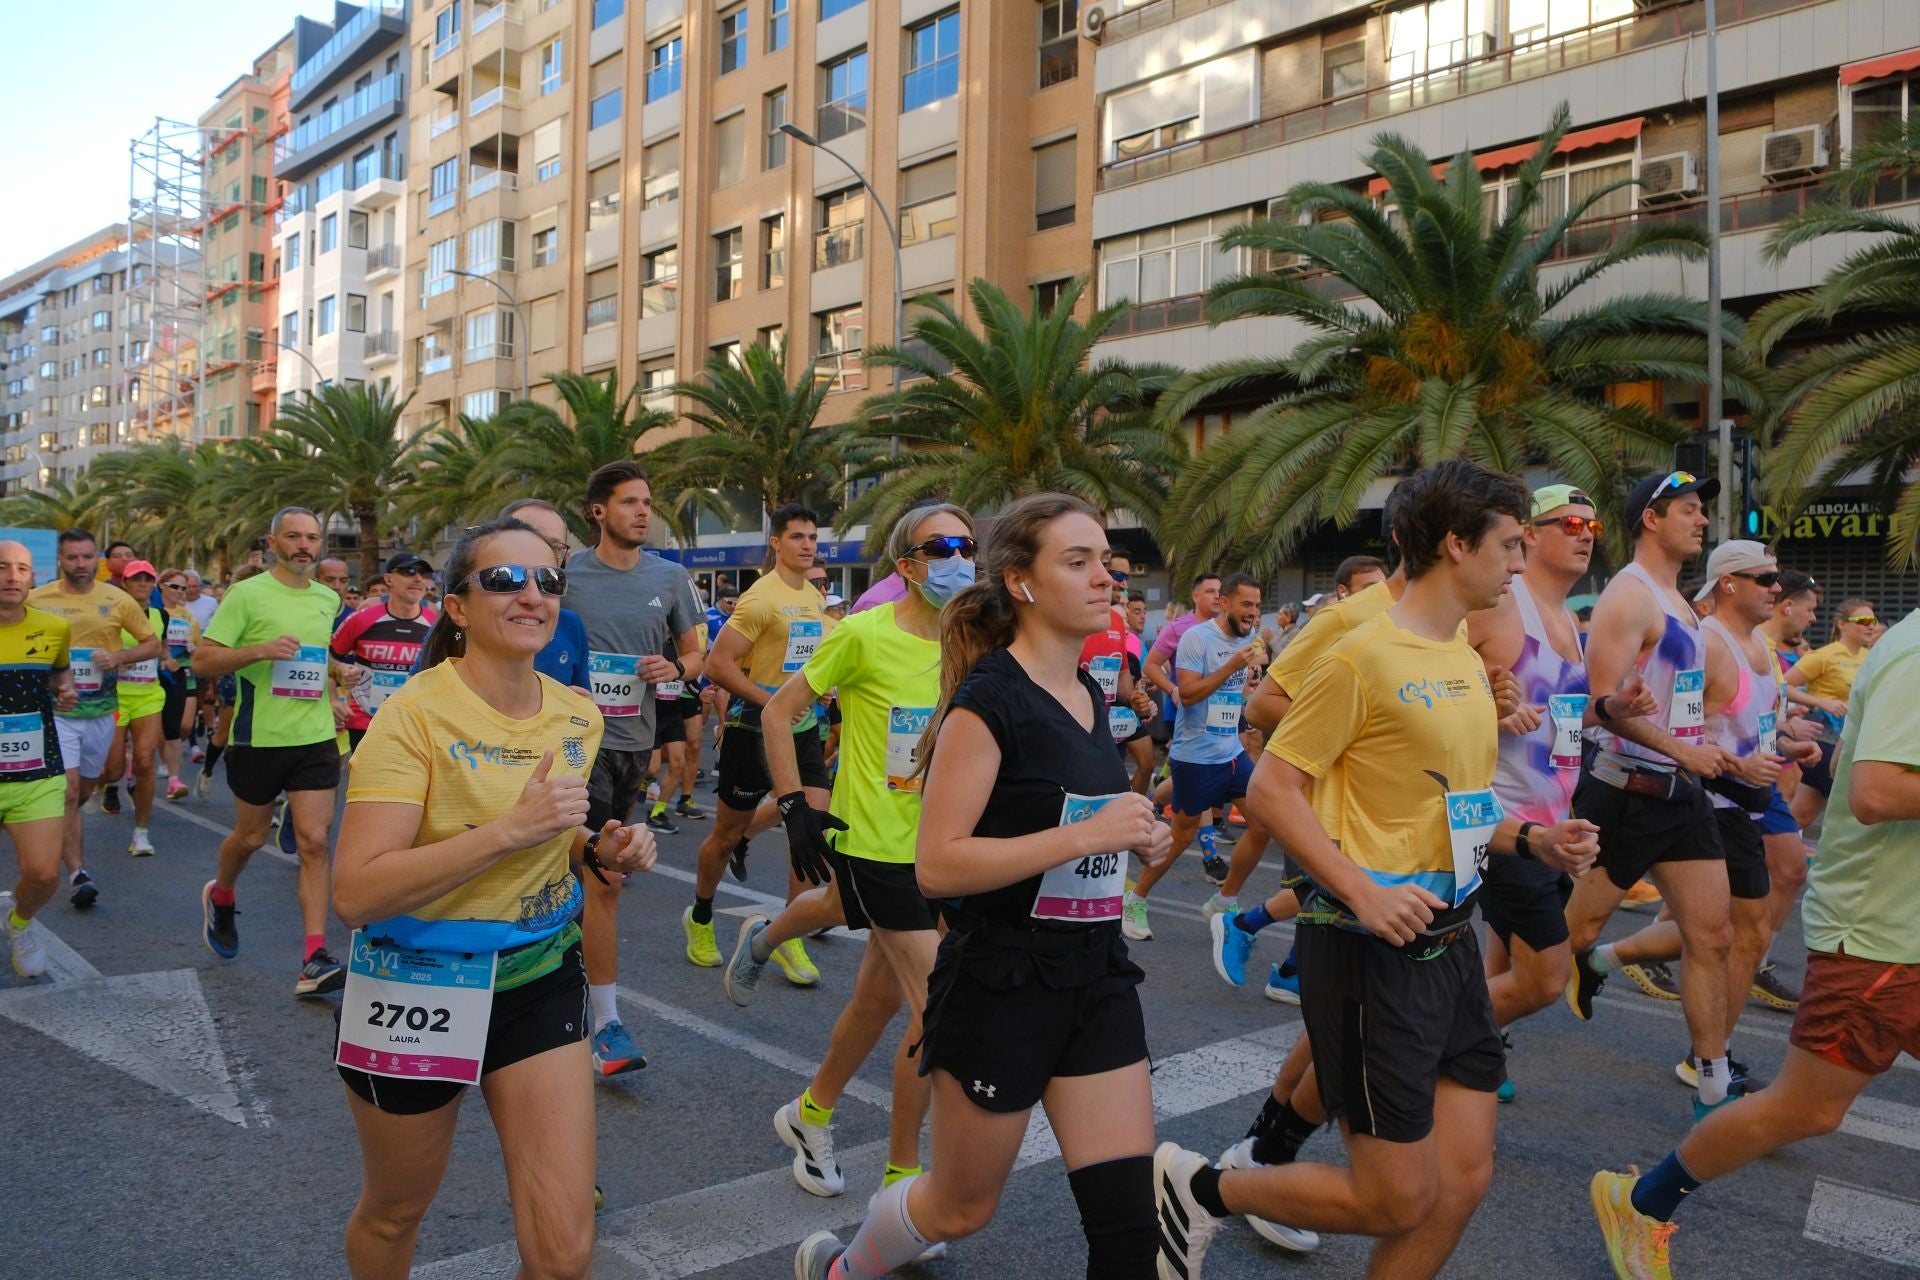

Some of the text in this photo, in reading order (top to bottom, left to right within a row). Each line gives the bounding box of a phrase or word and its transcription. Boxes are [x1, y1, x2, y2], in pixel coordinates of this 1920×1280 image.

[1803, 502, 1880, 515] ERBOLARI
[796, 645, 814, 655] 2246
[289, 670, 320, 681] 2622
[594, 682, 631, 696] 1040
[1112, 724, 1128, 732] 1722
[1075, 853, 1119, 879] 4802
[380, 949, 399, 969] VI
[410, 971, 432, 981] 2025
[368, 1001, 451, 1033] 2702
[389, 1035, 420, 1044] LAURA
